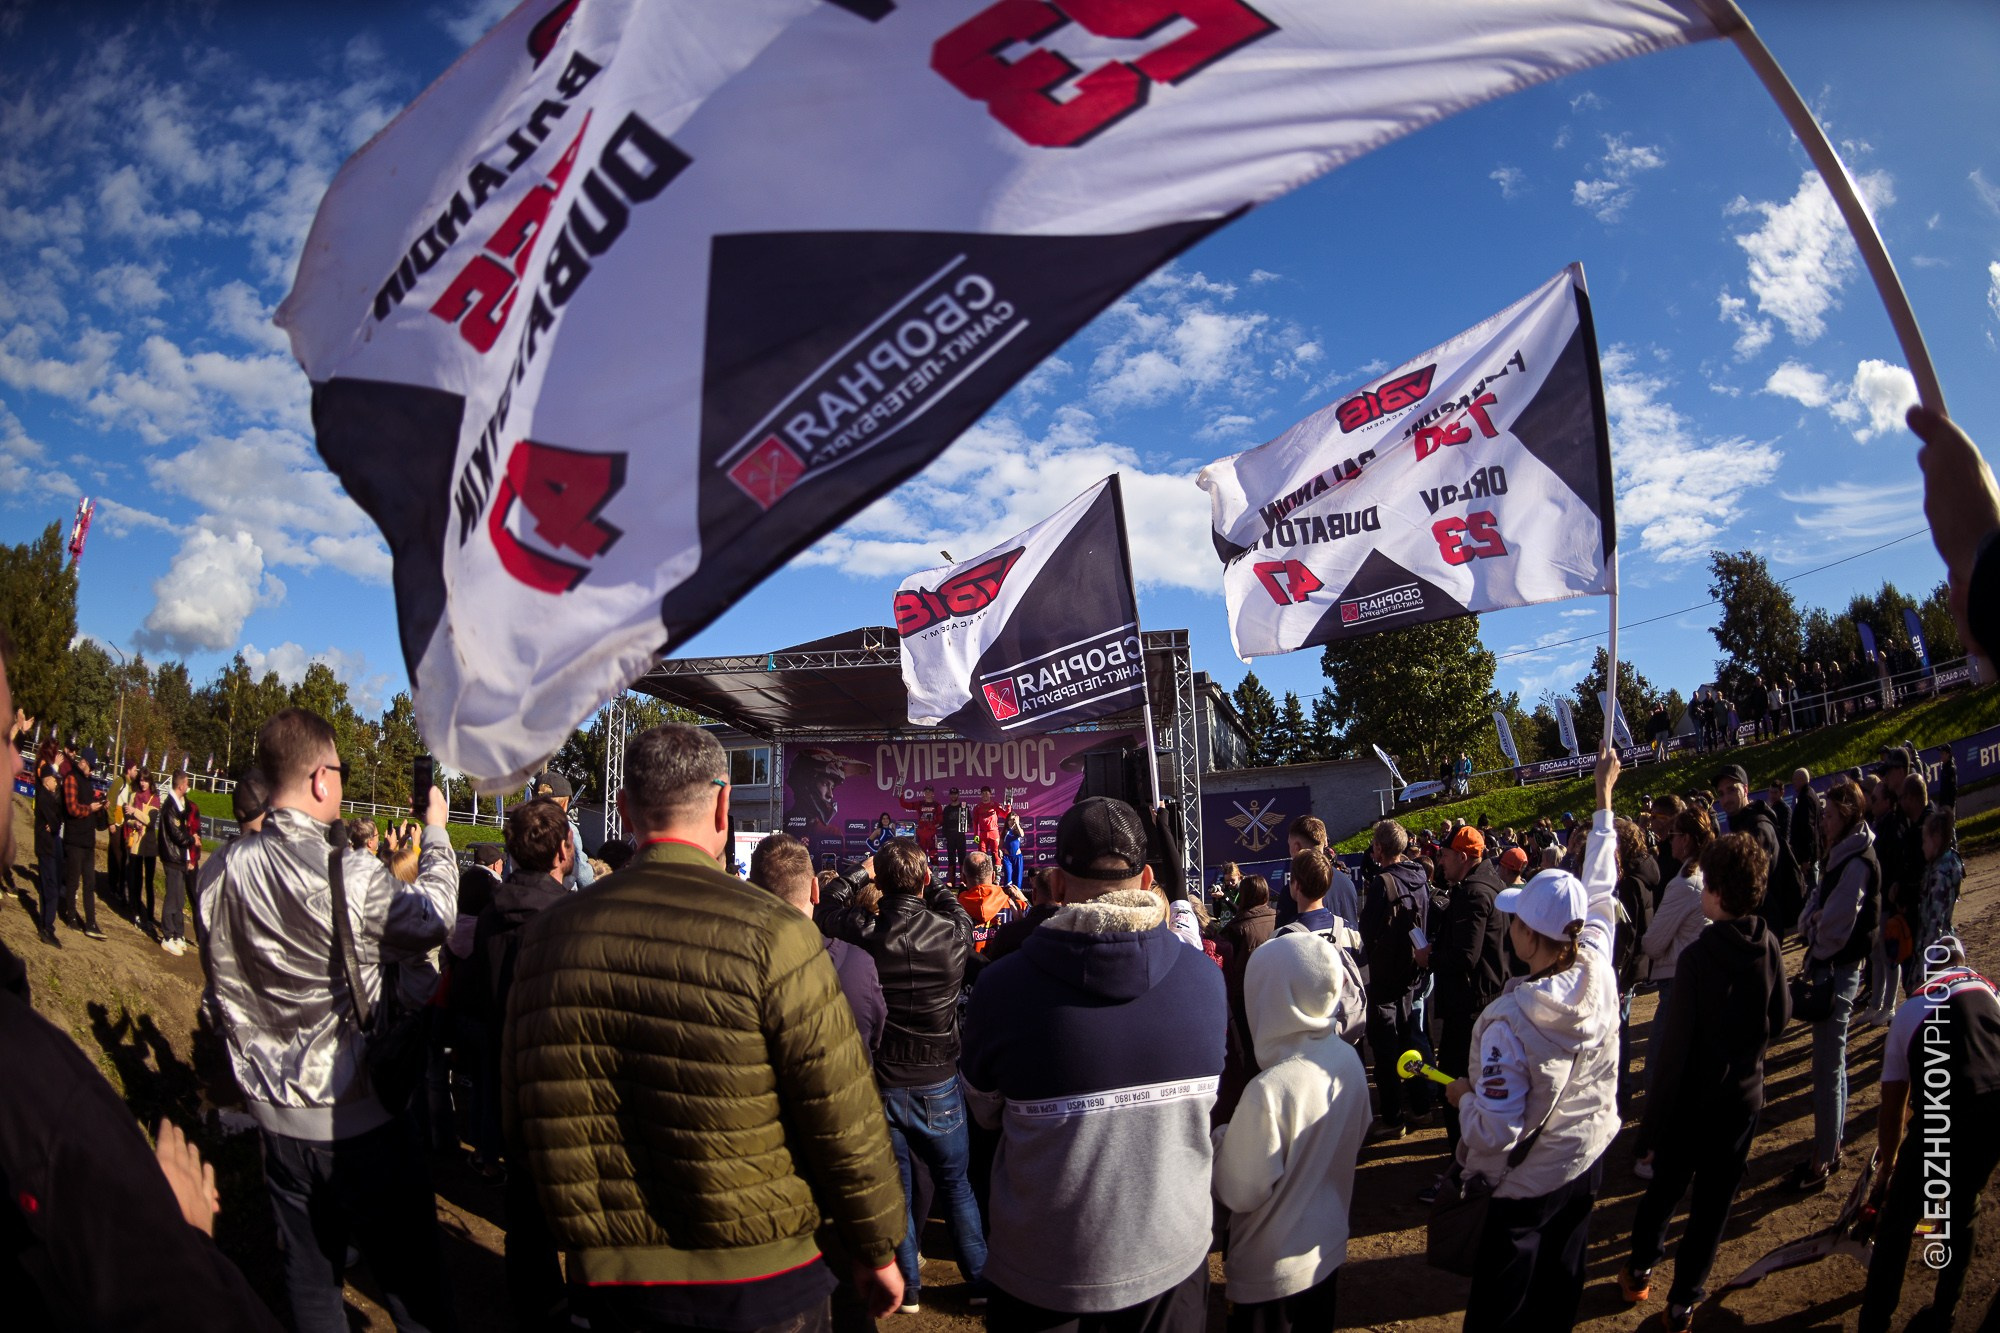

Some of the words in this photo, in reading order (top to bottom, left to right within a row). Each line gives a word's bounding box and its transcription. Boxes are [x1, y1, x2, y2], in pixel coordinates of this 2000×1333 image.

[876, 738, 1056, 791] СУПЕРКРОСС
[1539, 759, 1568, 772] ДОСААФ
[1569, 755, 1597, 767] РОССИИ
[1133, 1091, 1150, 1101] USPA
[1160, 1087, 1176, 1098] USPA
[1177, 1085, 1191, 1094] 1890
[1067, 1101, 1086, 1111] USPA
[1087, 1098, 1105, 1108] 1890
[1115, 1094, 1131, 1104] 1890
